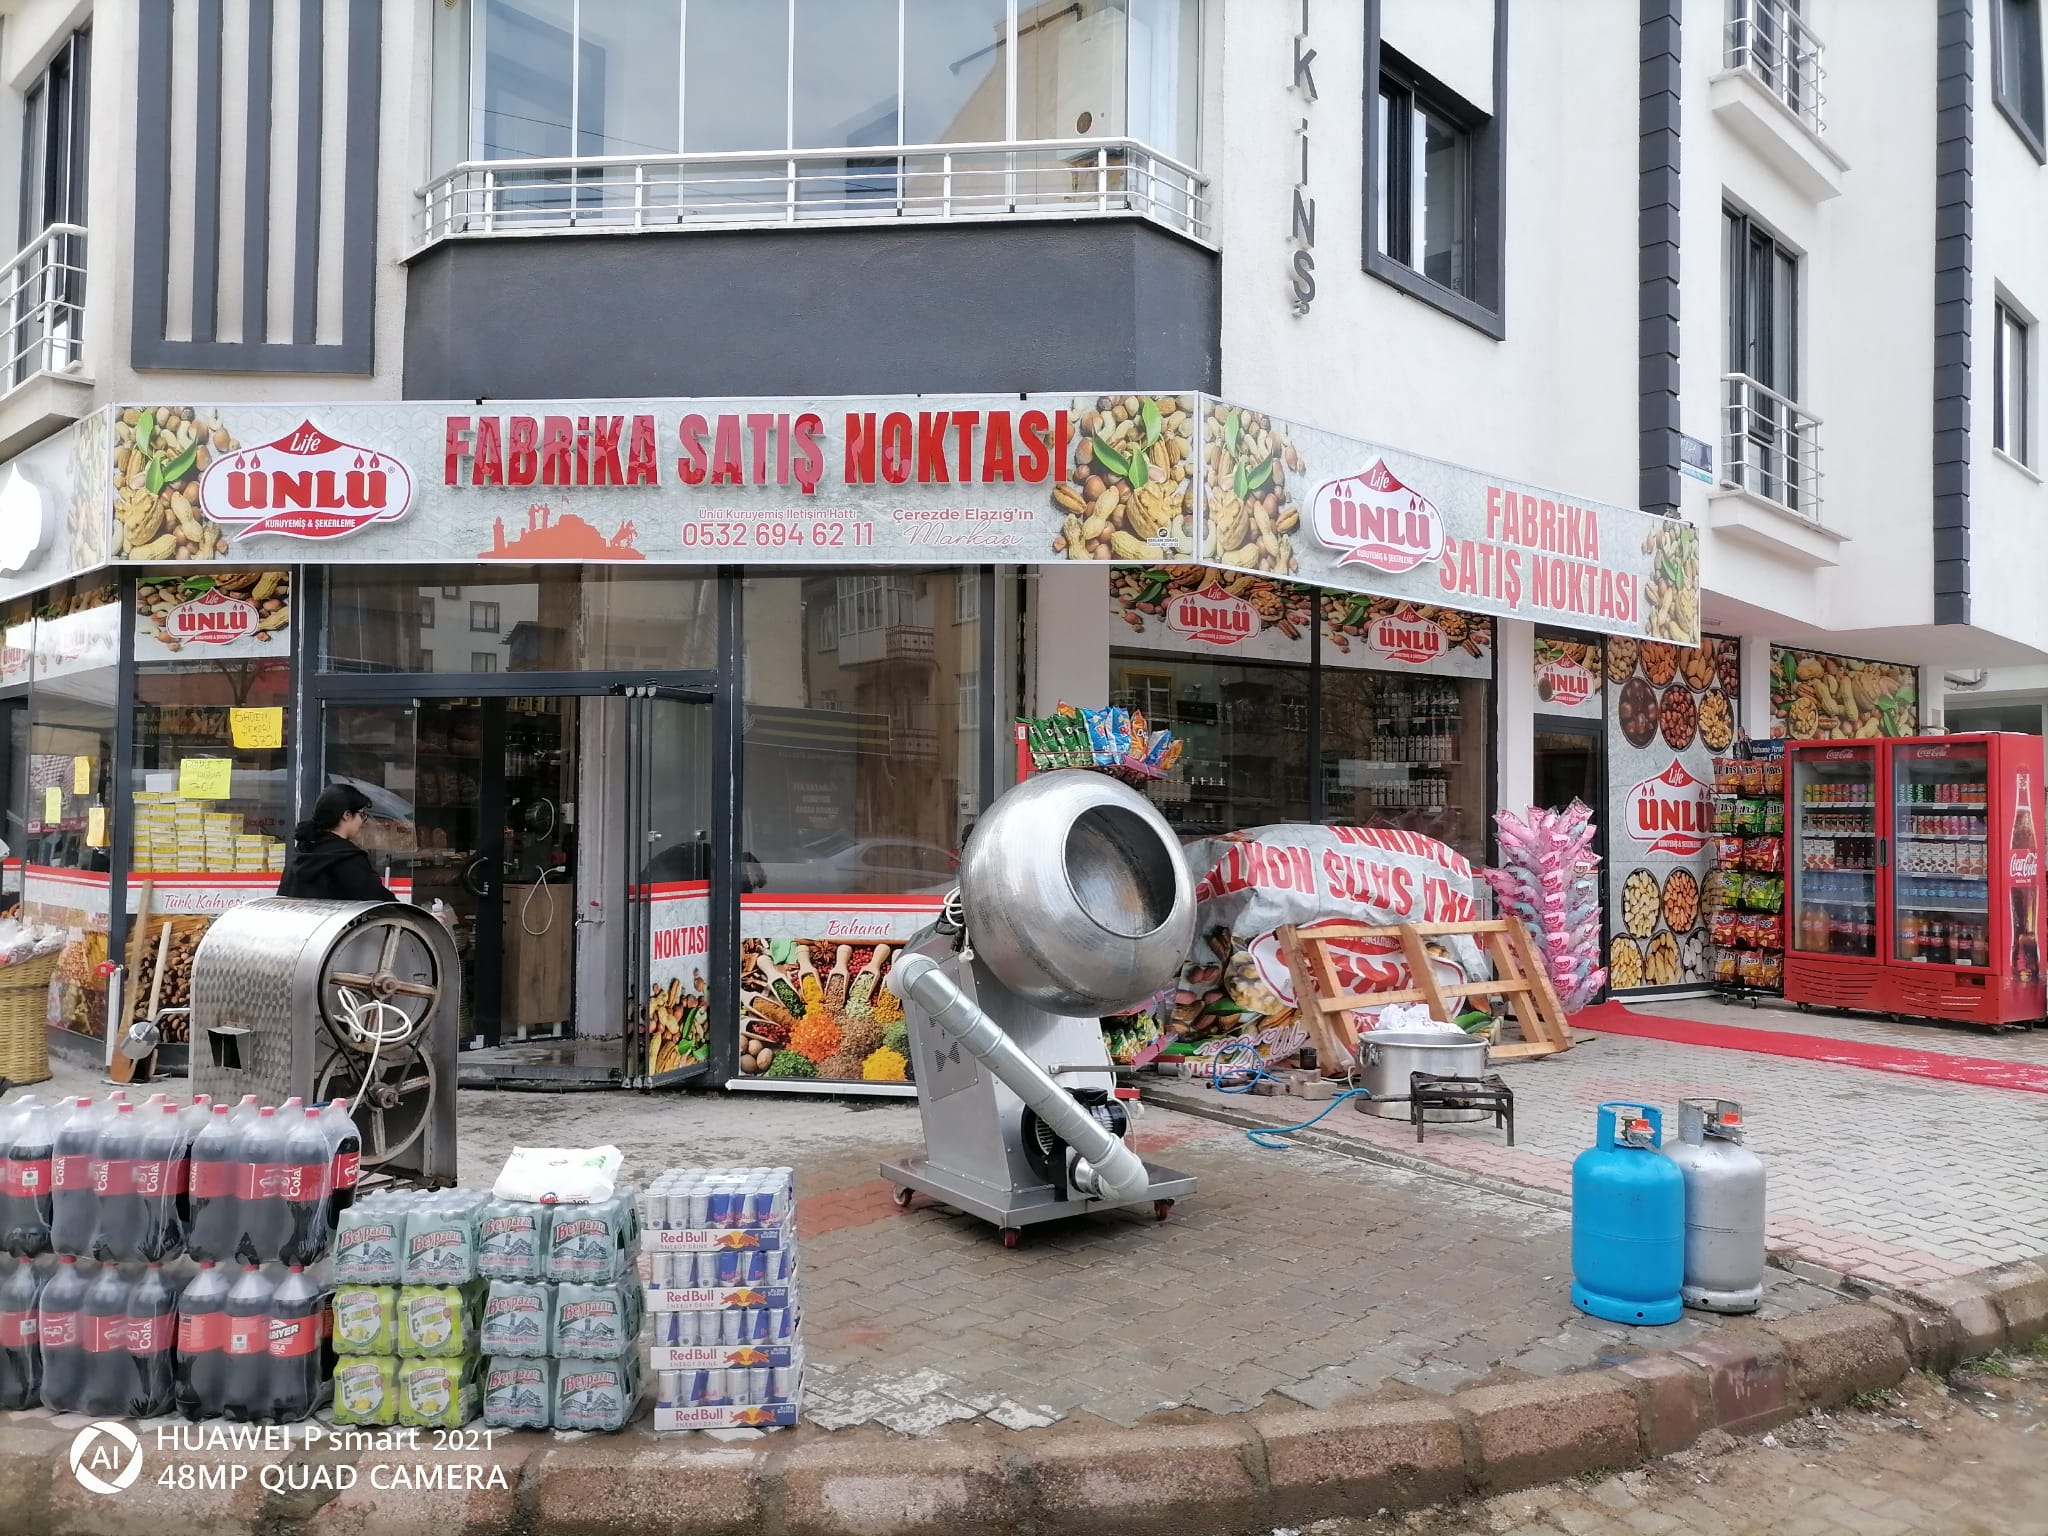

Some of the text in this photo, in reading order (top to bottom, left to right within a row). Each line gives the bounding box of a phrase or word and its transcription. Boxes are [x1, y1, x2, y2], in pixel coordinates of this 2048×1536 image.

[289, 431, 321, 455] Life
[677, 413, 825, 495] SATIŞ
[844, 409, 1069, 486] NOKTASI
[226, 451, 388, 510] ÜNLÜ
[1369, 469, 1391, 490] Life
[307, 519, 314, 528] &
[699, 506, 724, 520] Ünlü
[726, 508, 785, 523] Kuruyemiş
[892, 508, 961, 523] Çerezde
[1329, 481, 1432, 551] ÜNLÜ
[682, 521, 874, 547] 0532 694 62 11
[1439, 535, 1639, 624] SATIŞ NOKTASI
[177, 603, 249, 632] ÜNLÜ
[1179, 596, 1251, 633] ÜNLÜ
[1379, 620, 1440, 652] ÜNLÜ
[1667, 766, 1684, 786] Life
[164, 893, 192, 910] Türk
[827, 917, 891, 937] Baharat
[653, 924, 709, 961] NOKTASI
[97, 1161, 110, 1192] Cola
[146, 1162, 161, 1193] Cola
[289, 1167, 303, 1198] Cola
[660, 1231, 708, 1244] Red Bull
[666, 1289, 714, 1302] Red Bull
[140, 1319, 154, 1350] Cola
[669, 1348, 717, 1361] Red Bull
[675, 1408, 723, 1421] Red Bull
